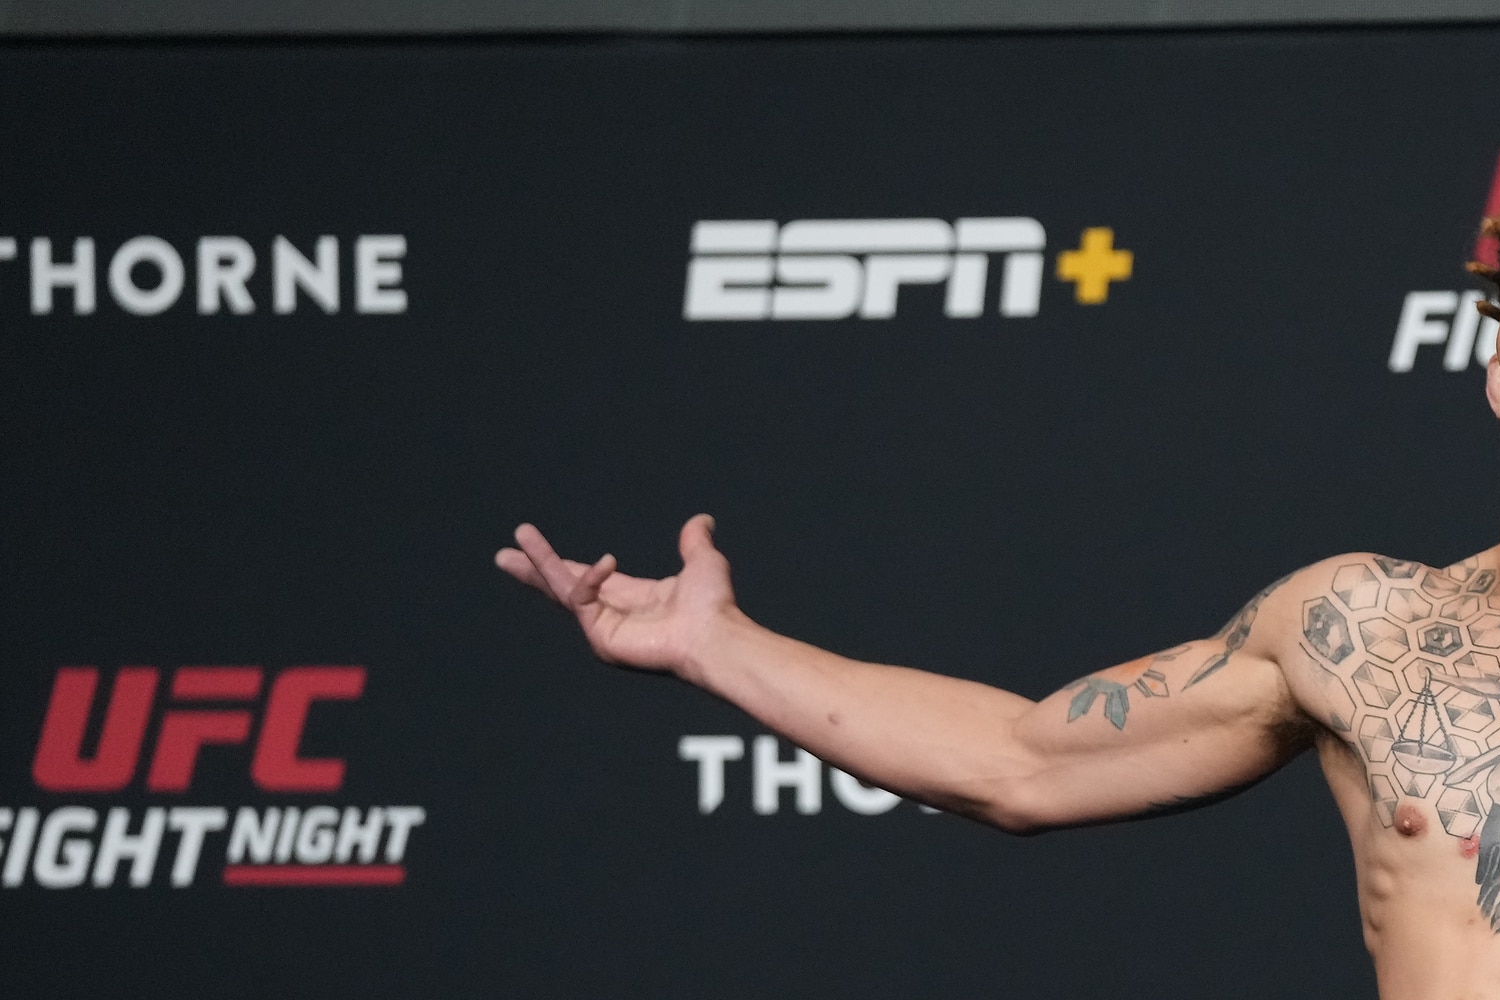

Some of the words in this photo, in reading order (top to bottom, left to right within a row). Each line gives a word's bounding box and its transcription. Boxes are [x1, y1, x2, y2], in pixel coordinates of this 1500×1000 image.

[0, 235, 408, 317] HORNE
[32, 666, 367, 793] UFC
[0, 806, 228, 889] IGHT
[227, 806, 426, 865] NIGHT
